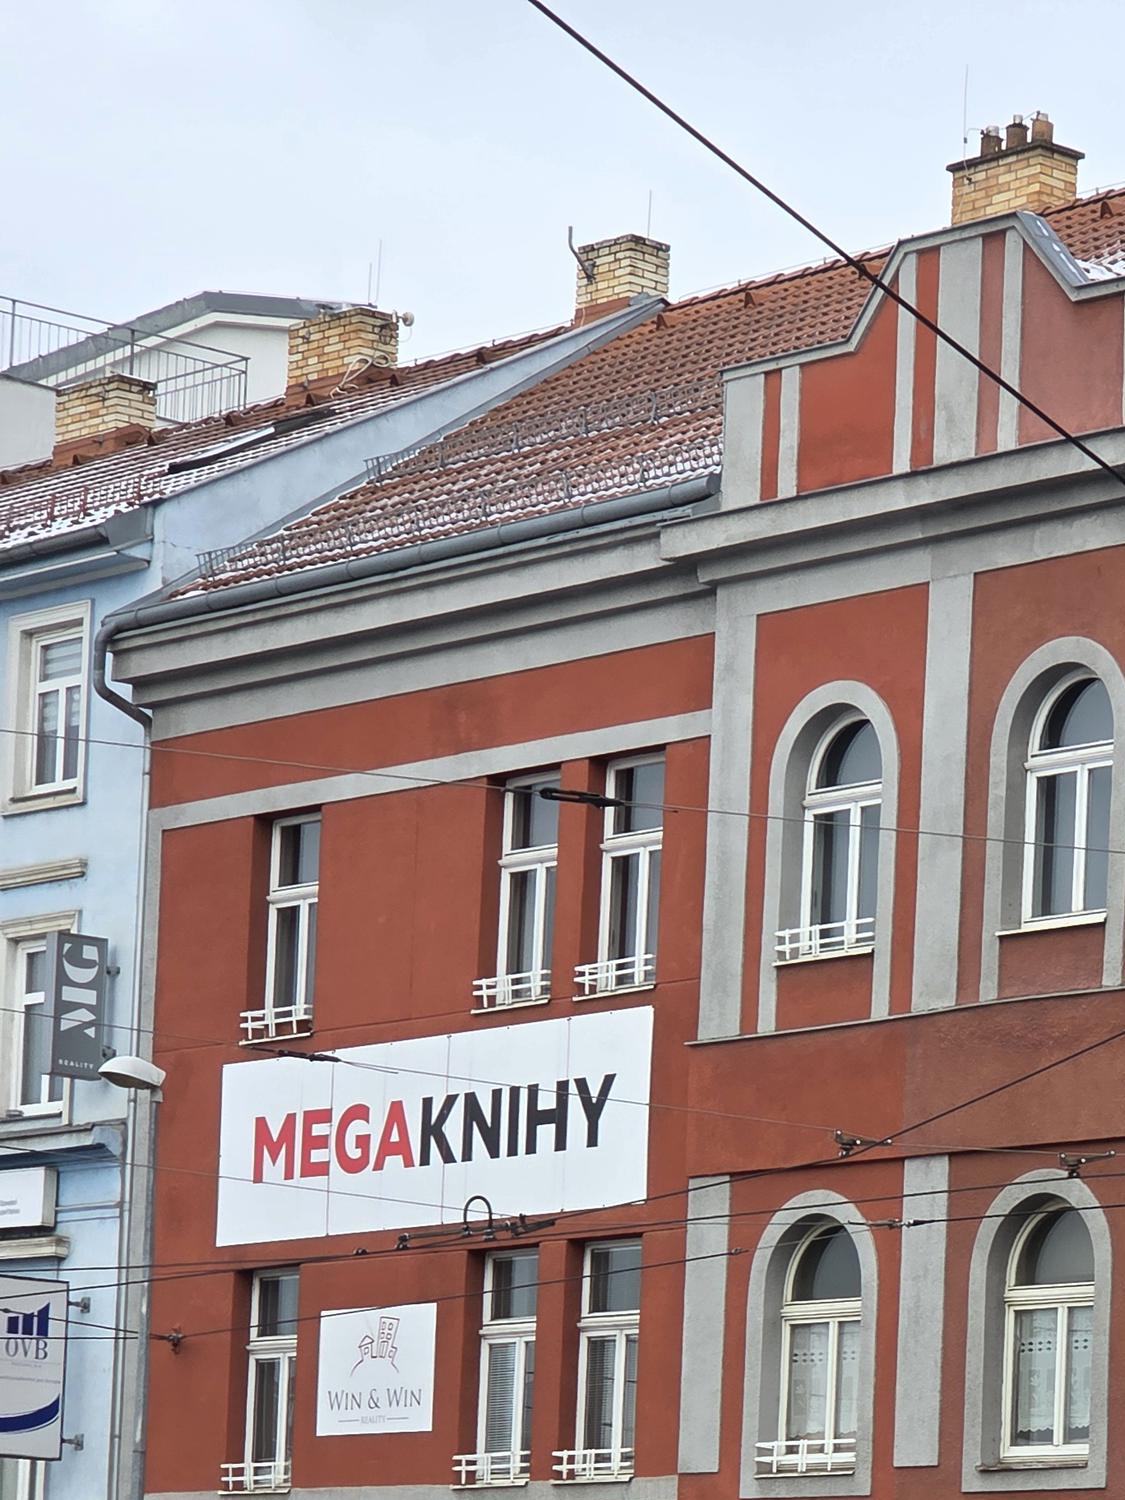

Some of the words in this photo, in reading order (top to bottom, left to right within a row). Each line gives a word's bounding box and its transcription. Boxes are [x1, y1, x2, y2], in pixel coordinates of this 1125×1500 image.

[253, 1073, 617, 1184] MEGAKNIHY
[5, 1336, 48, 1361] OVB
[367, 1388, 381, 1410] &
